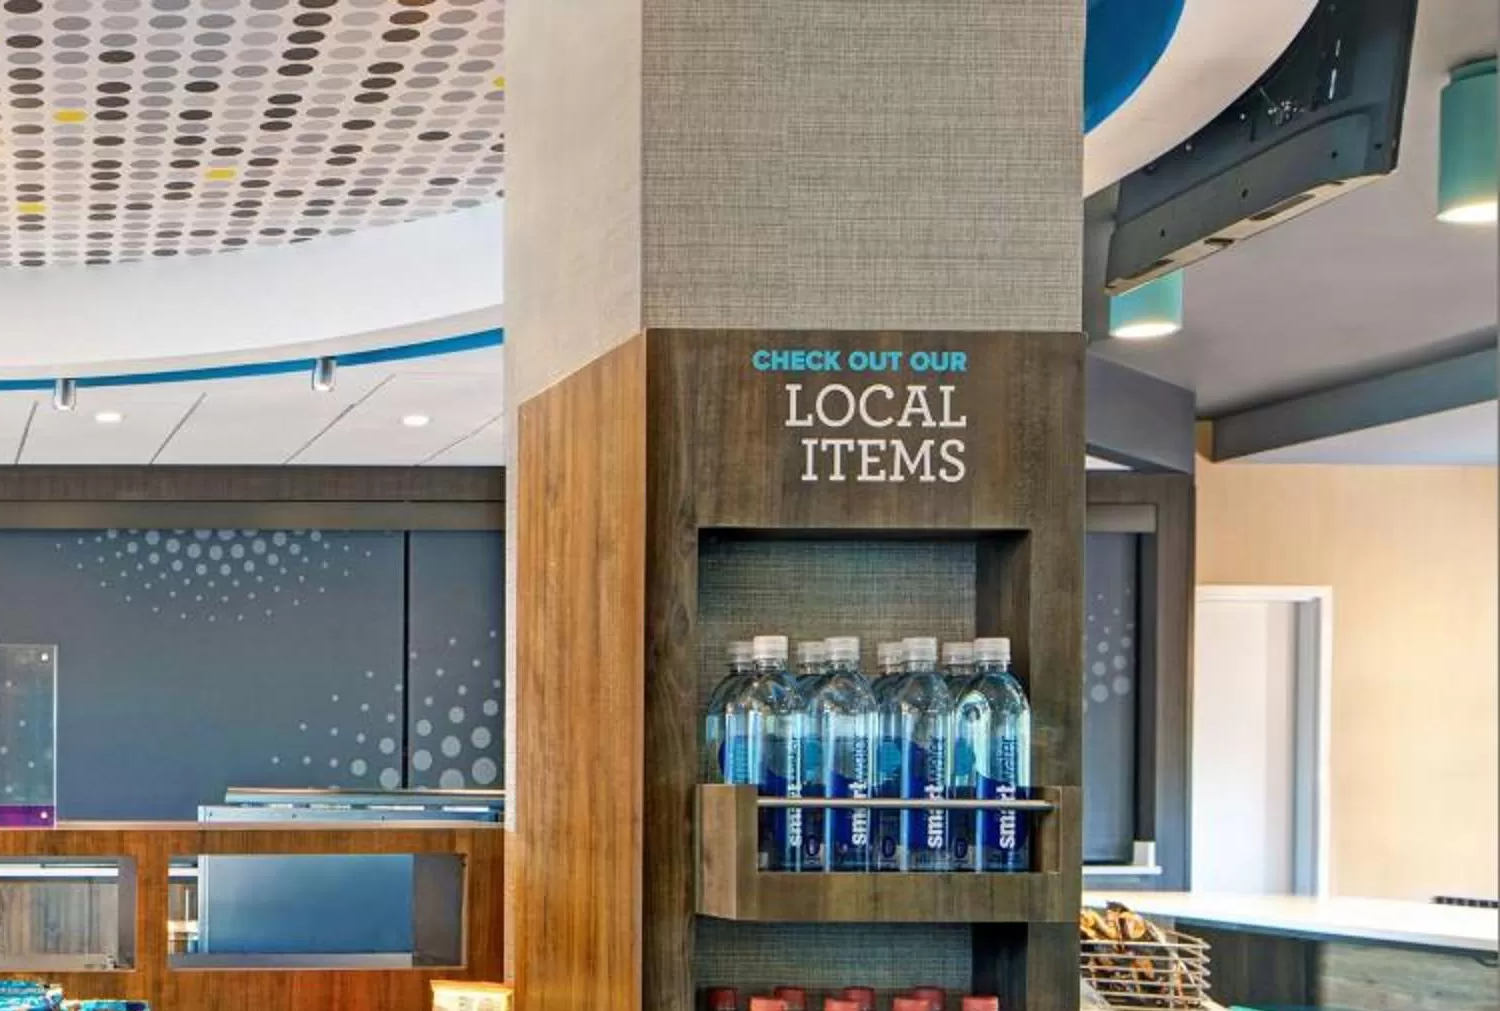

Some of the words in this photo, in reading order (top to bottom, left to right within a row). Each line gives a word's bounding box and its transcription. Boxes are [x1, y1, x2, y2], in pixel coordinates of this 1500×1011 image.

[752, 350, 841, 372] CHECK
[849, 350, 903, 372] OUT
[910, 351, 968, 372] OUR
[785, 383, 967, 428] LOCAL
[800, 438, 966, 482] ITEMS
